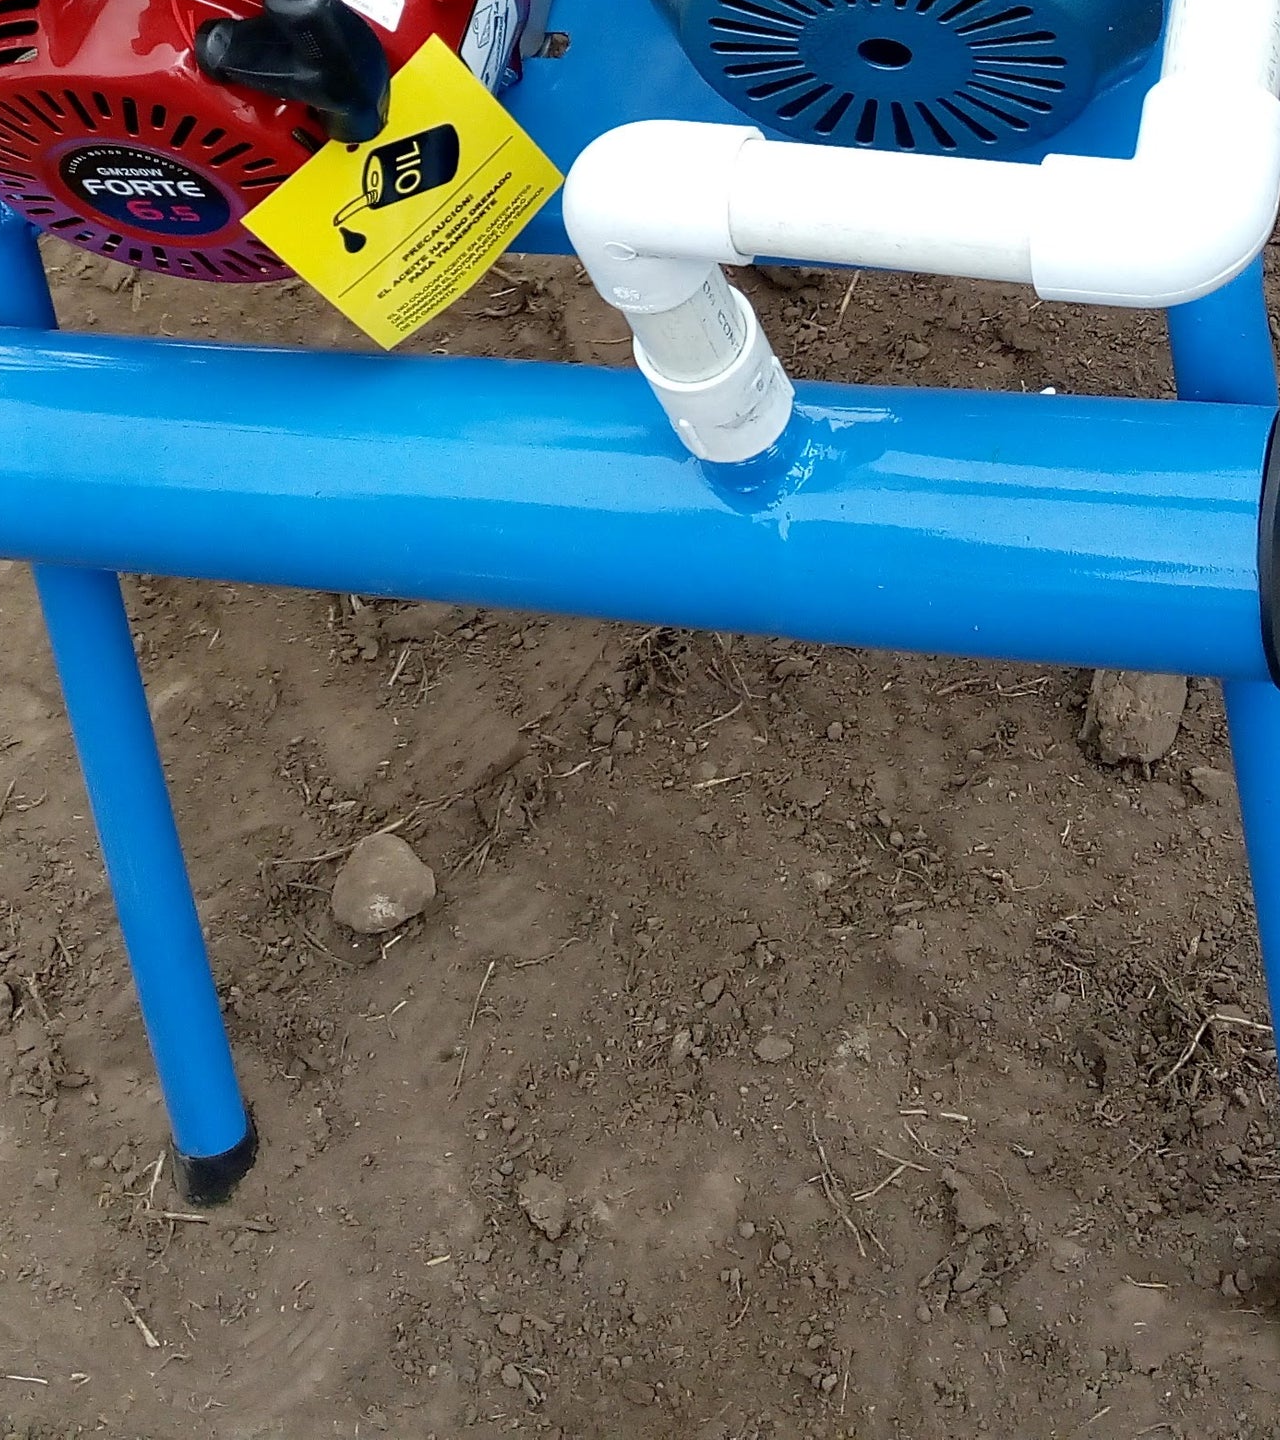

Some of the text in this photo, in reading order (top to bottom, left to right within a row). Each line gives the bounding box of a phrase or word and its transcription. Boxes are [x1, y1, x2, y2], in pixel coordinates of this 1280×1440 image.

[96, 167, 163, 177] GM200W
[395, 140, 422, 195] OIL
[82, 178, 206, 198] FORTE
[126, 198, 201, 222] 6.5
[377, 172, 512, 299] EL ACEITE HA SIDO DRENADO
[408, 198, 498, 283] PARA TRANSPORTE
